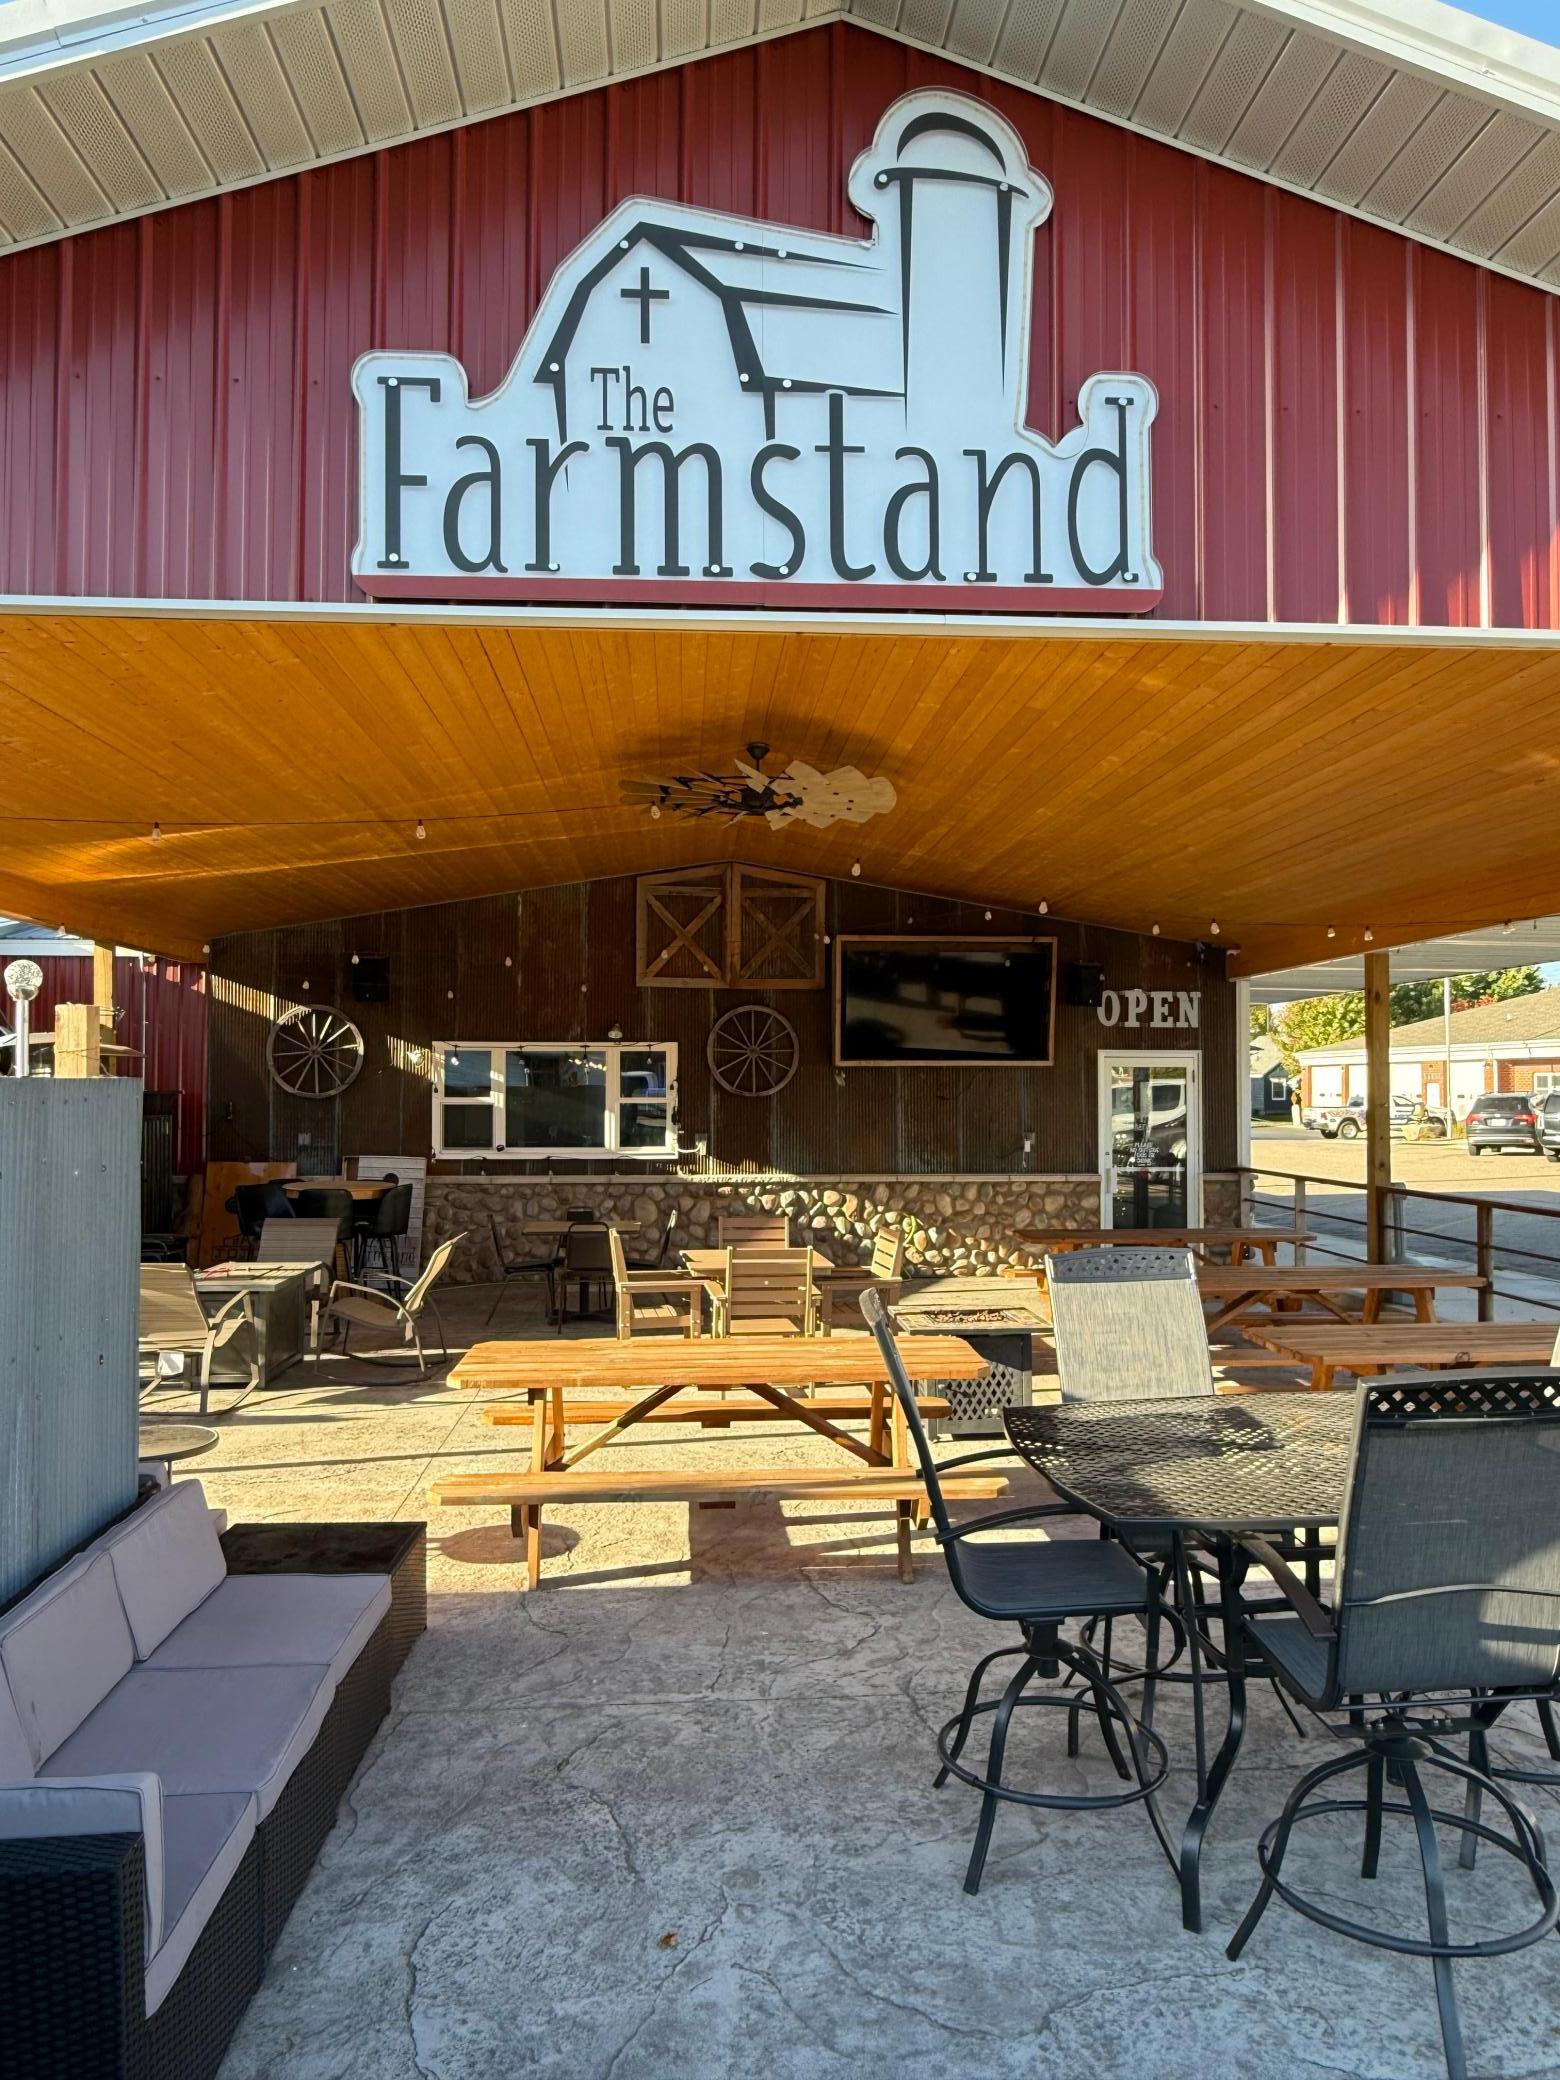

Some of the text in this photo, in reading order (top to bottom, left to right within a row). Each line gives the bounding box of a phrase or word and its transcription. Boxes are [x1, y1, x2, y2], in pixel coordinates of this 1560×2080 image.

[590, 365, 674, 433] The
[377, 377, 1139, 586] Farmstand
[1097, 989, 1201, 1028] OPEN
